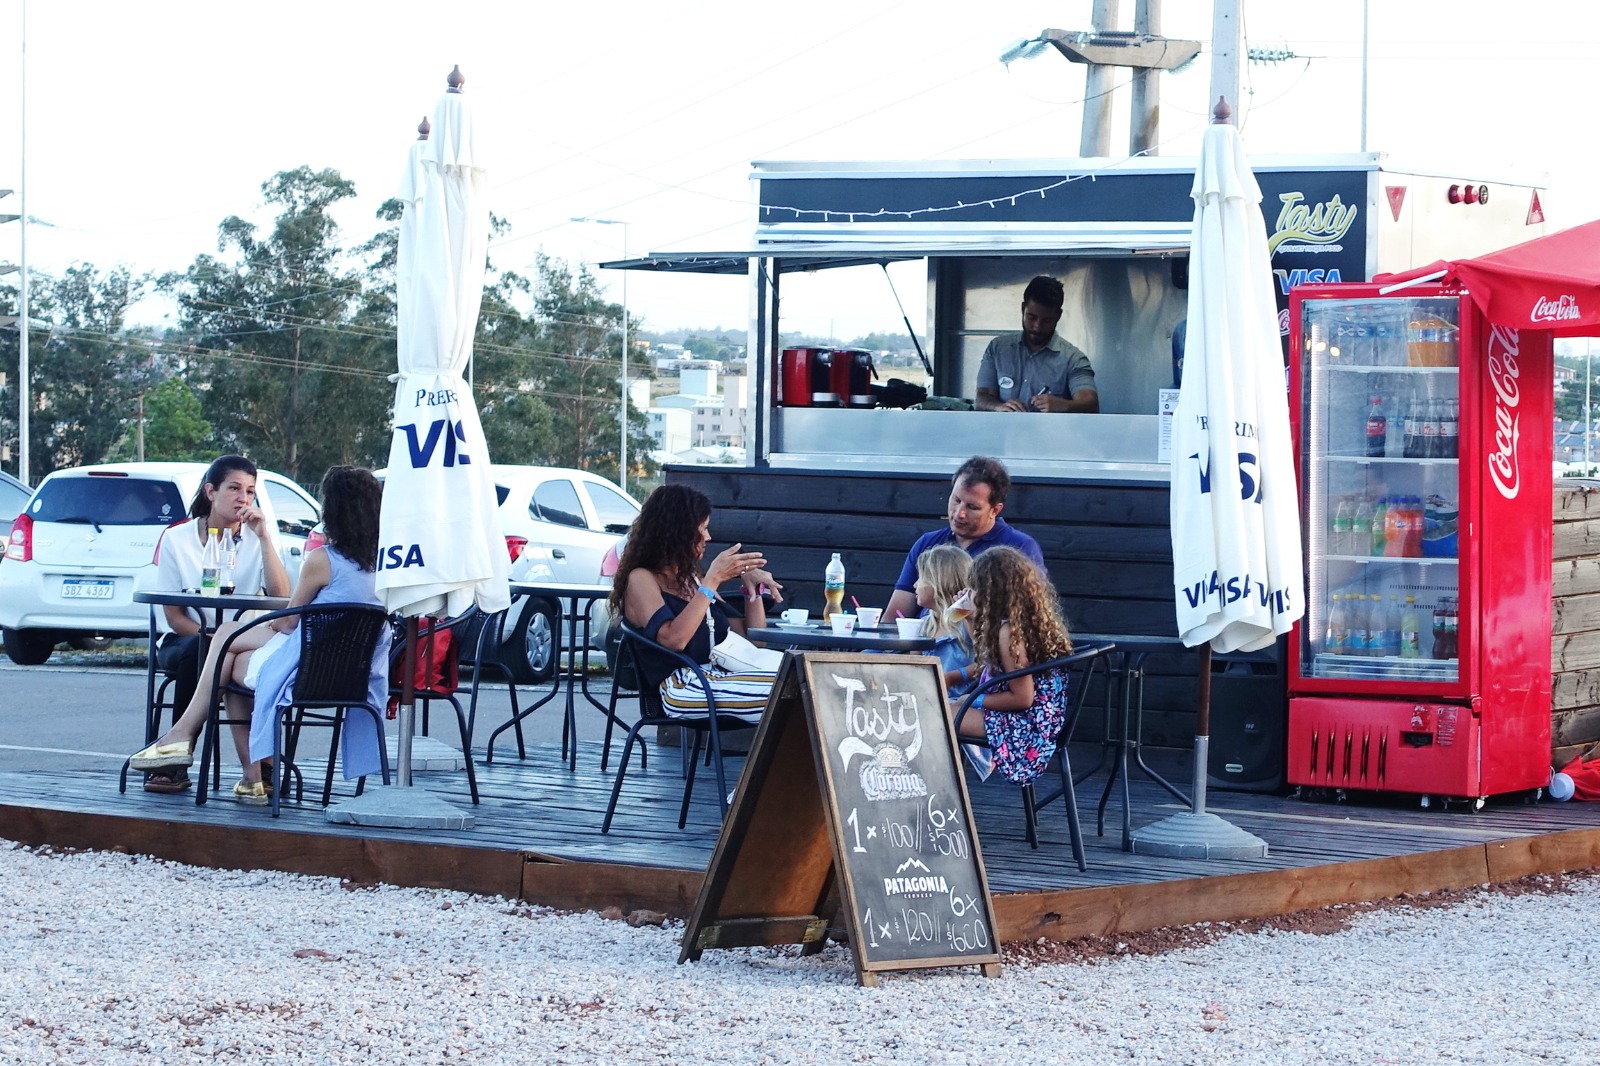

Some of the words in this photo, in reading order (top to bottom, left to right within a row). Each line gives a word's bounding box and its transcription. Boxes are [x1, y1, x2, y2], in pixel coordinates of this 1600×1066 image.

[1273, 192, 1357, 245] Tasty
[395, 419, 471, 468] VIS
[377, 544, 424, 571] ISA
[64, 585, 82, 596] SBZ
[86, 586, 110, 596] 4367
[831, 673, 923, 763] Tasty
[862, 766, 921, 796] Corona
[883, 875, 950, 897] PATAGONIA
